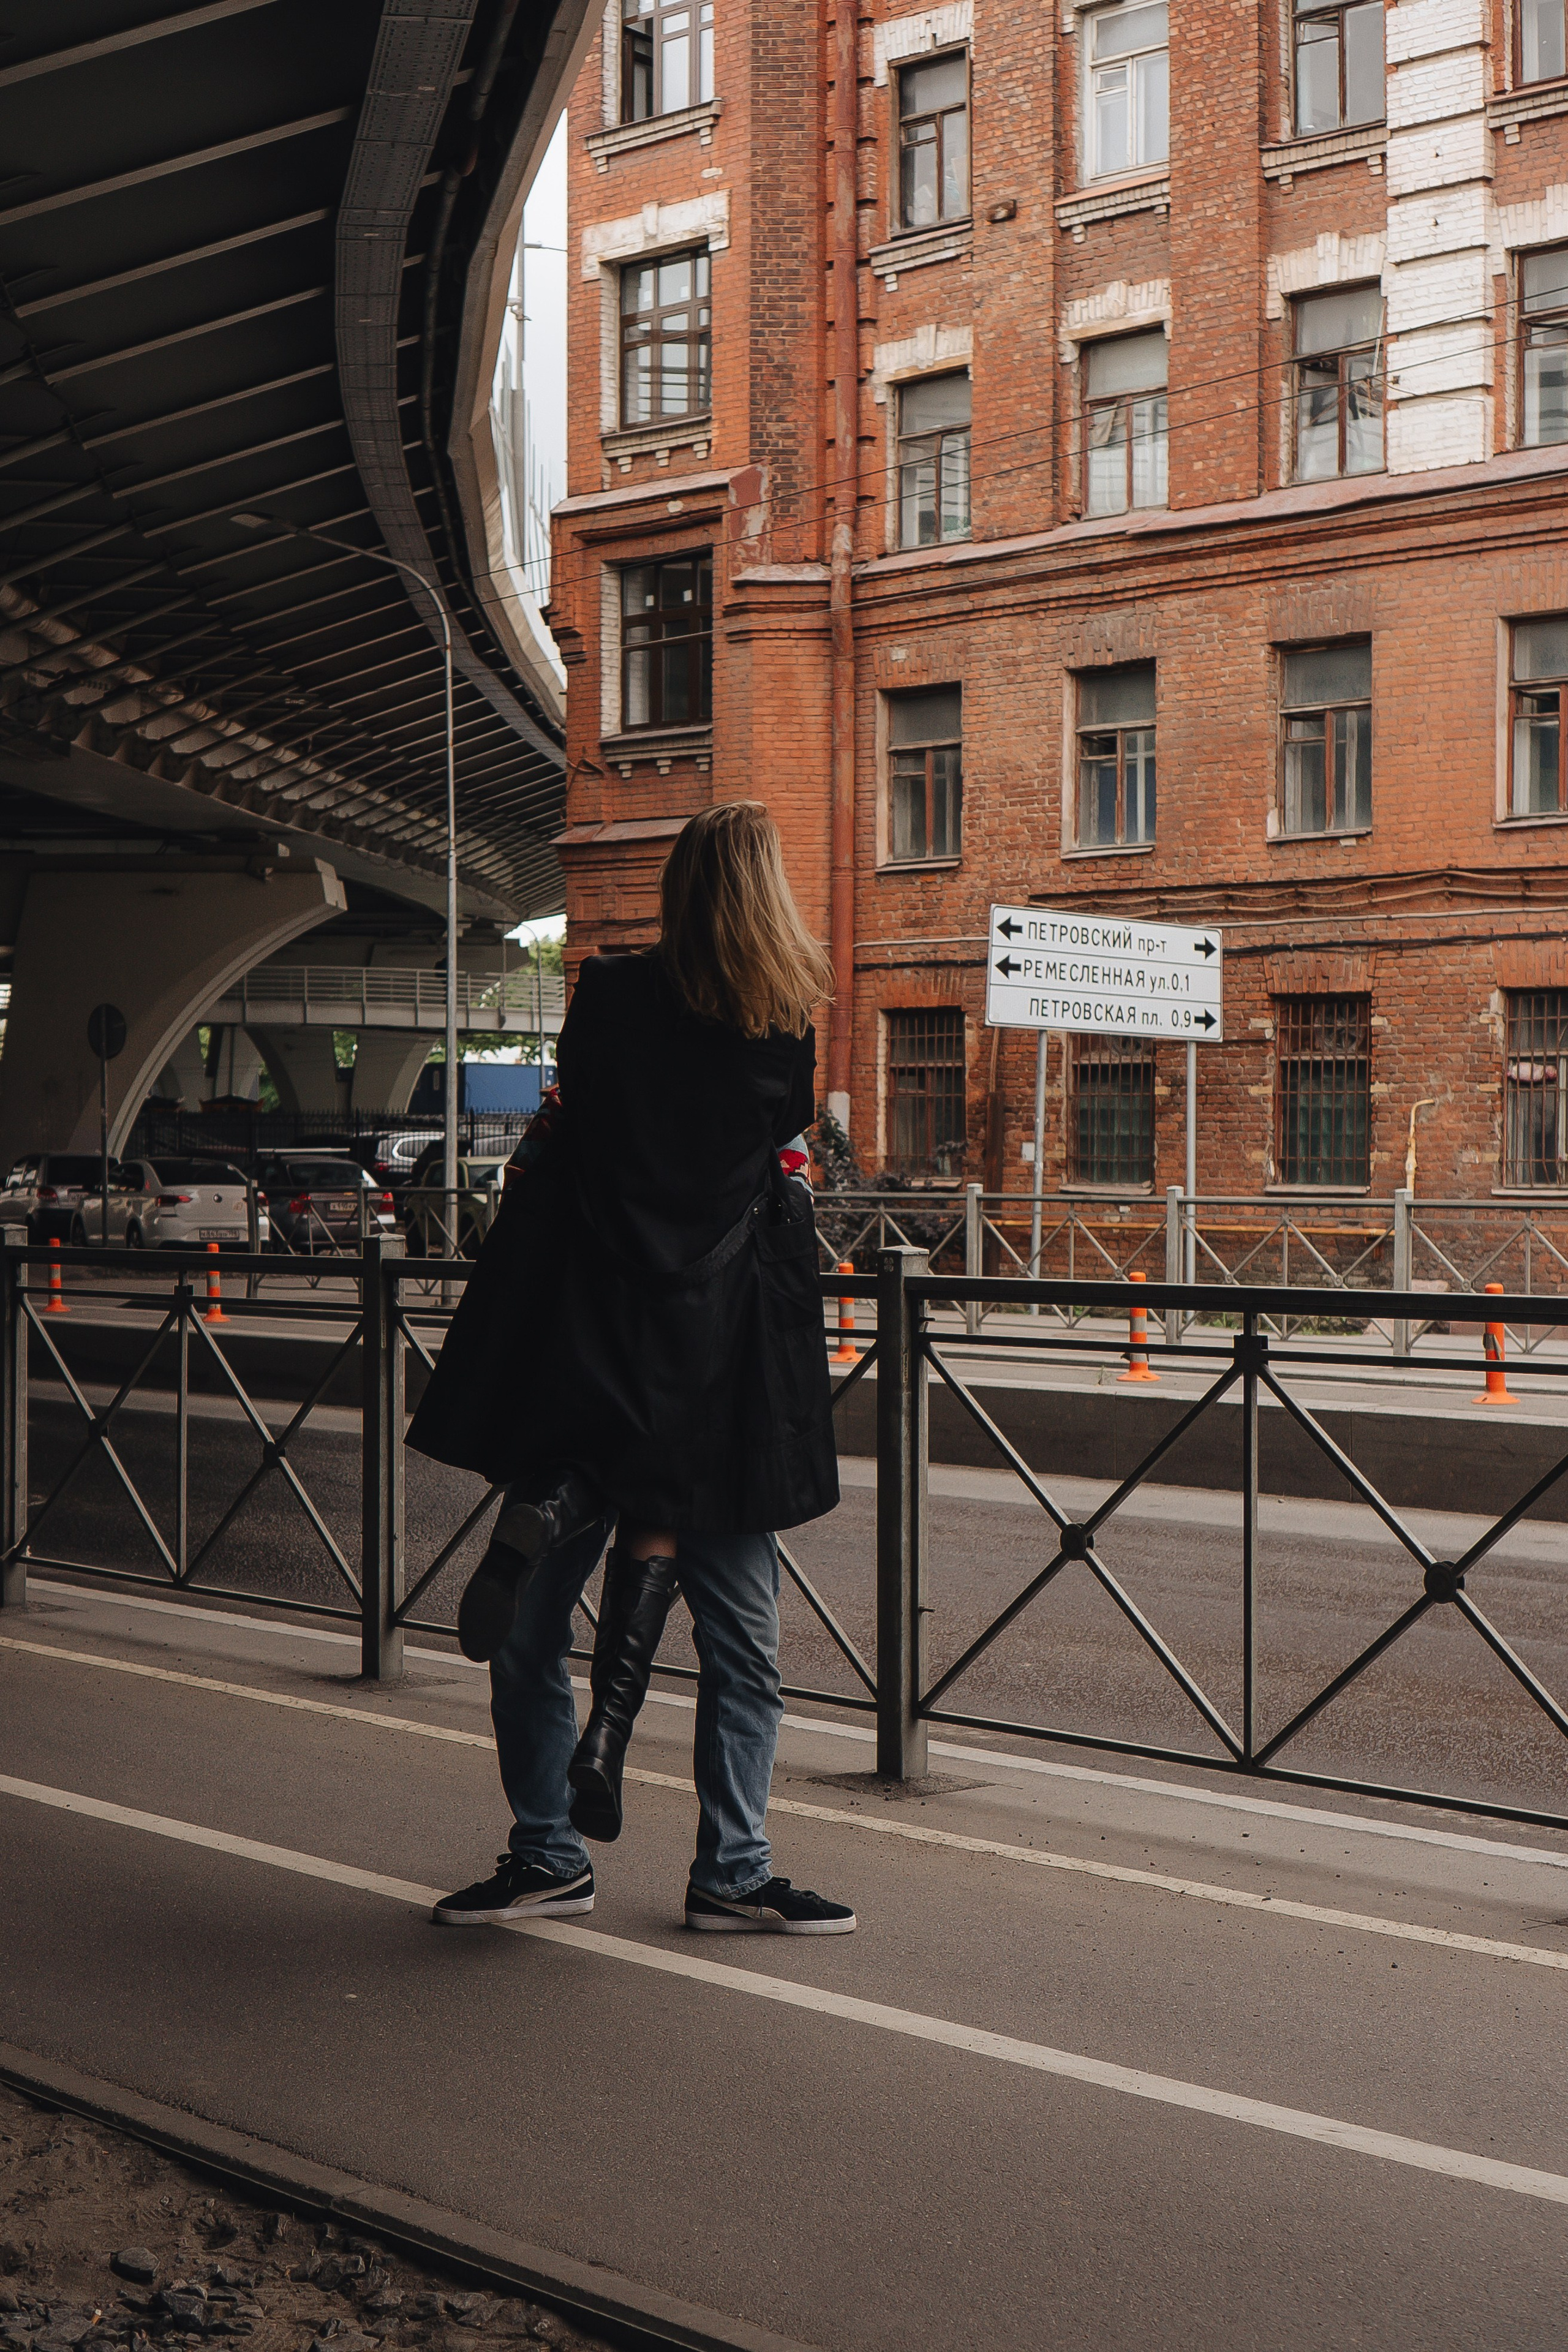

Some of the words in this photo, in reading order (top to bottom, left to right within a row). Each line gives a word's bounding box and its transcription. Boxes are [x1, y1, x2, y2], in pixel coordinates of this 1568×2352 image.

[1028, 921, 1132, 949] ПЕТРОВСКИЙ
[1138, 938, 1166, 956] пр-т
[1023, 959, 1144, 988] РЕМЕСЛЕННАЯ
[1030, 998, 1135, 1023] ПЕТРОВСКАЯ
[1142, 1012, 1162, 1025] пл.
[1171, 1009, 1191, 1027] 0,9
